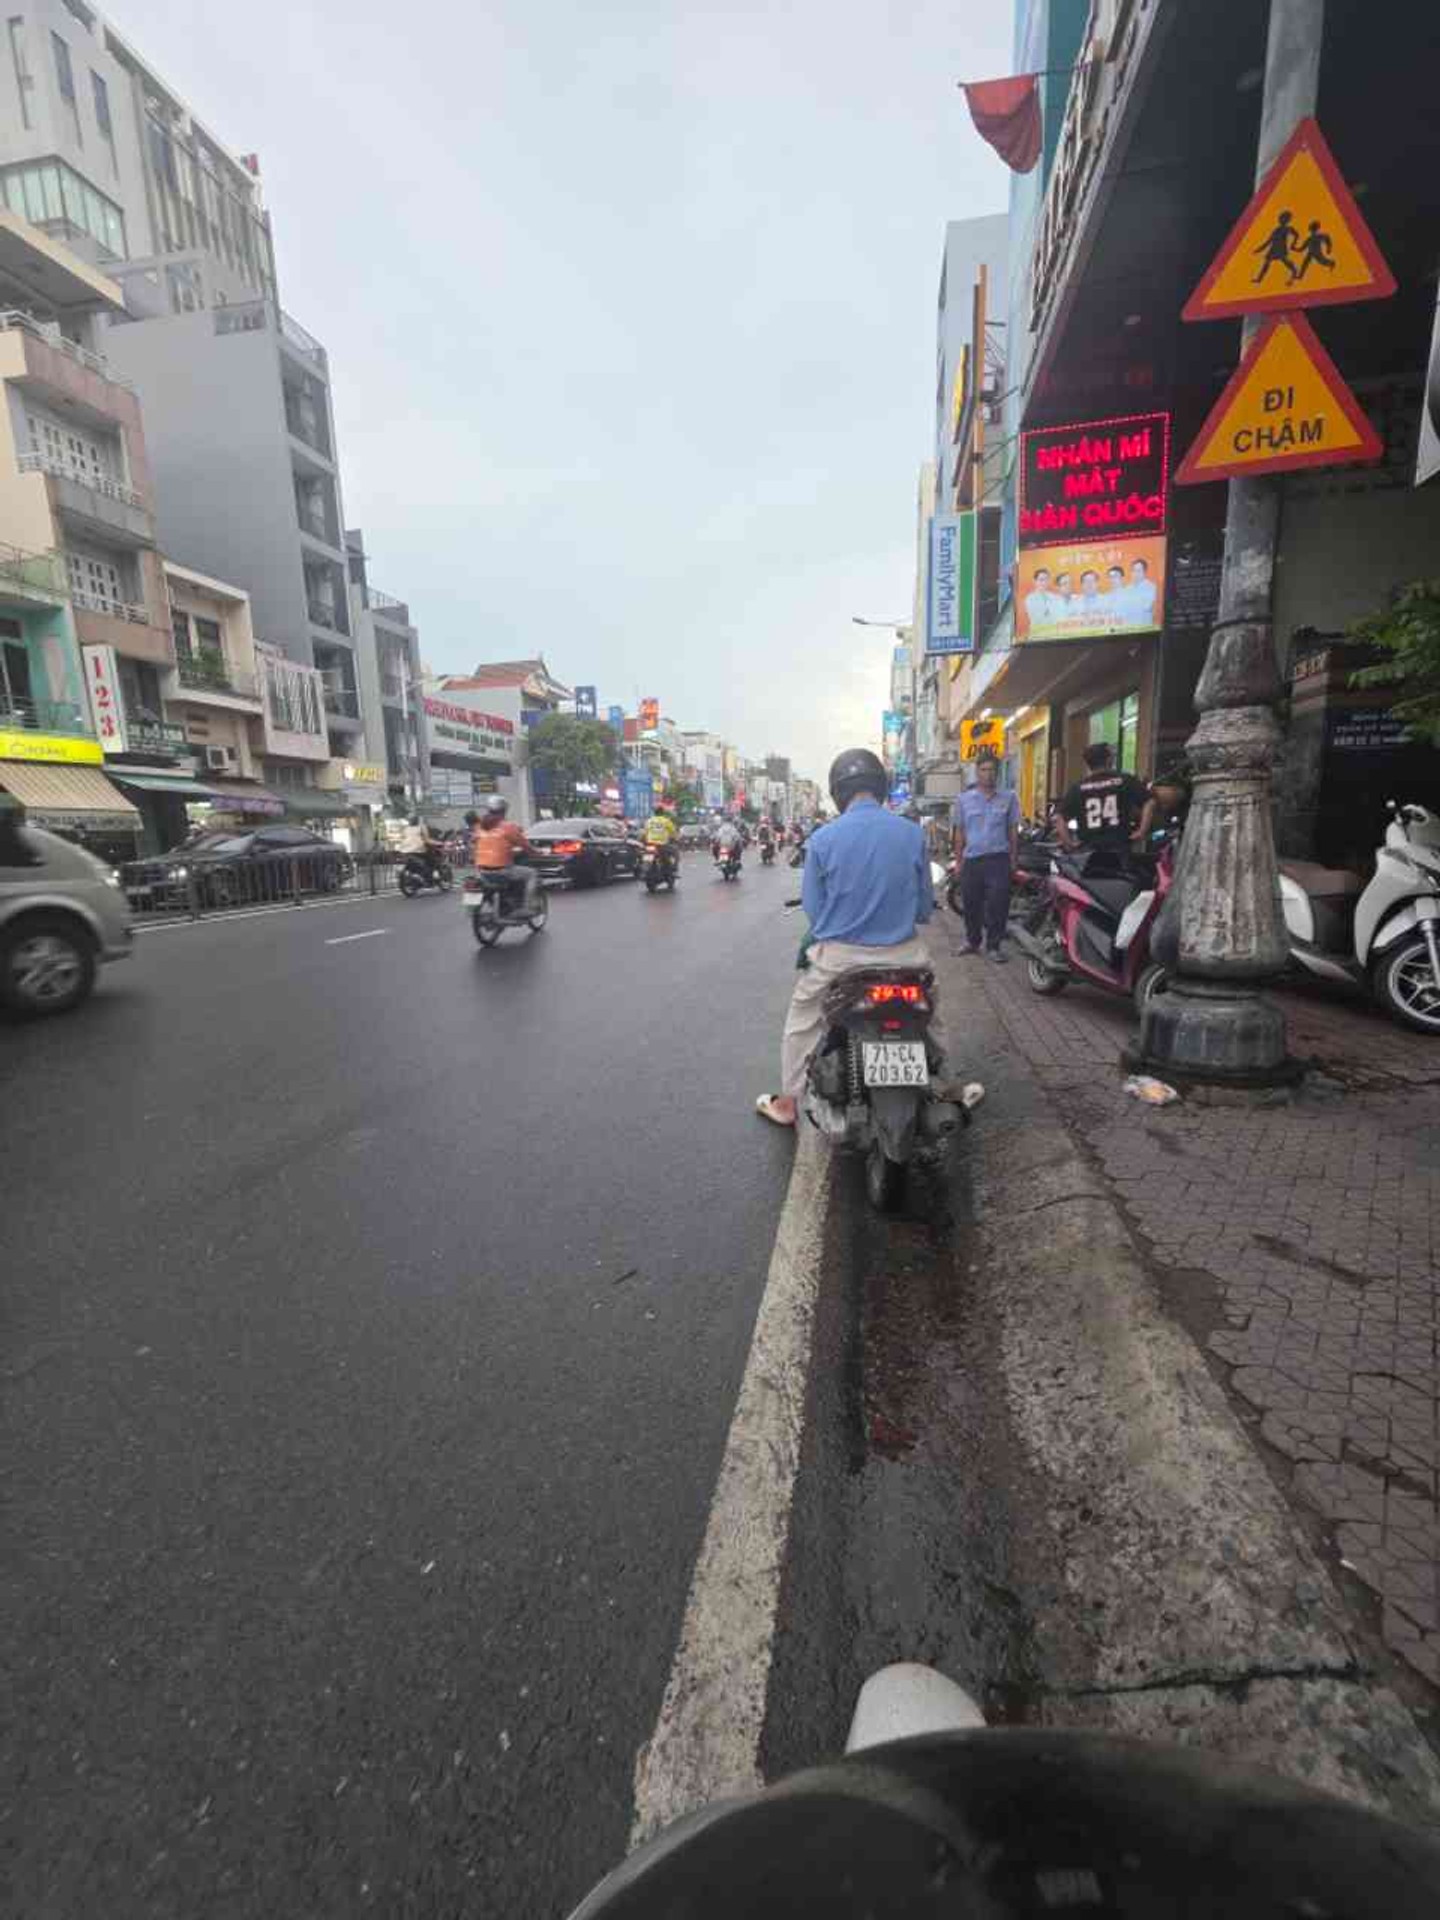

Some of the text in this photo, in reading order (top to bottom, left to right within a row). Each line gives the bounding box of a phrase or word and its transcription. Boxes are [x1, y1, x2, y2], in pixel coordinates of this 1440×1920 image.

[1263, 386, 1294, 412] ĐI
[1233, 417, 1326, 453] CHẬM
[937, 526, 957, 628] FamilyMart
[1085, 794, 1120, 829] 24
